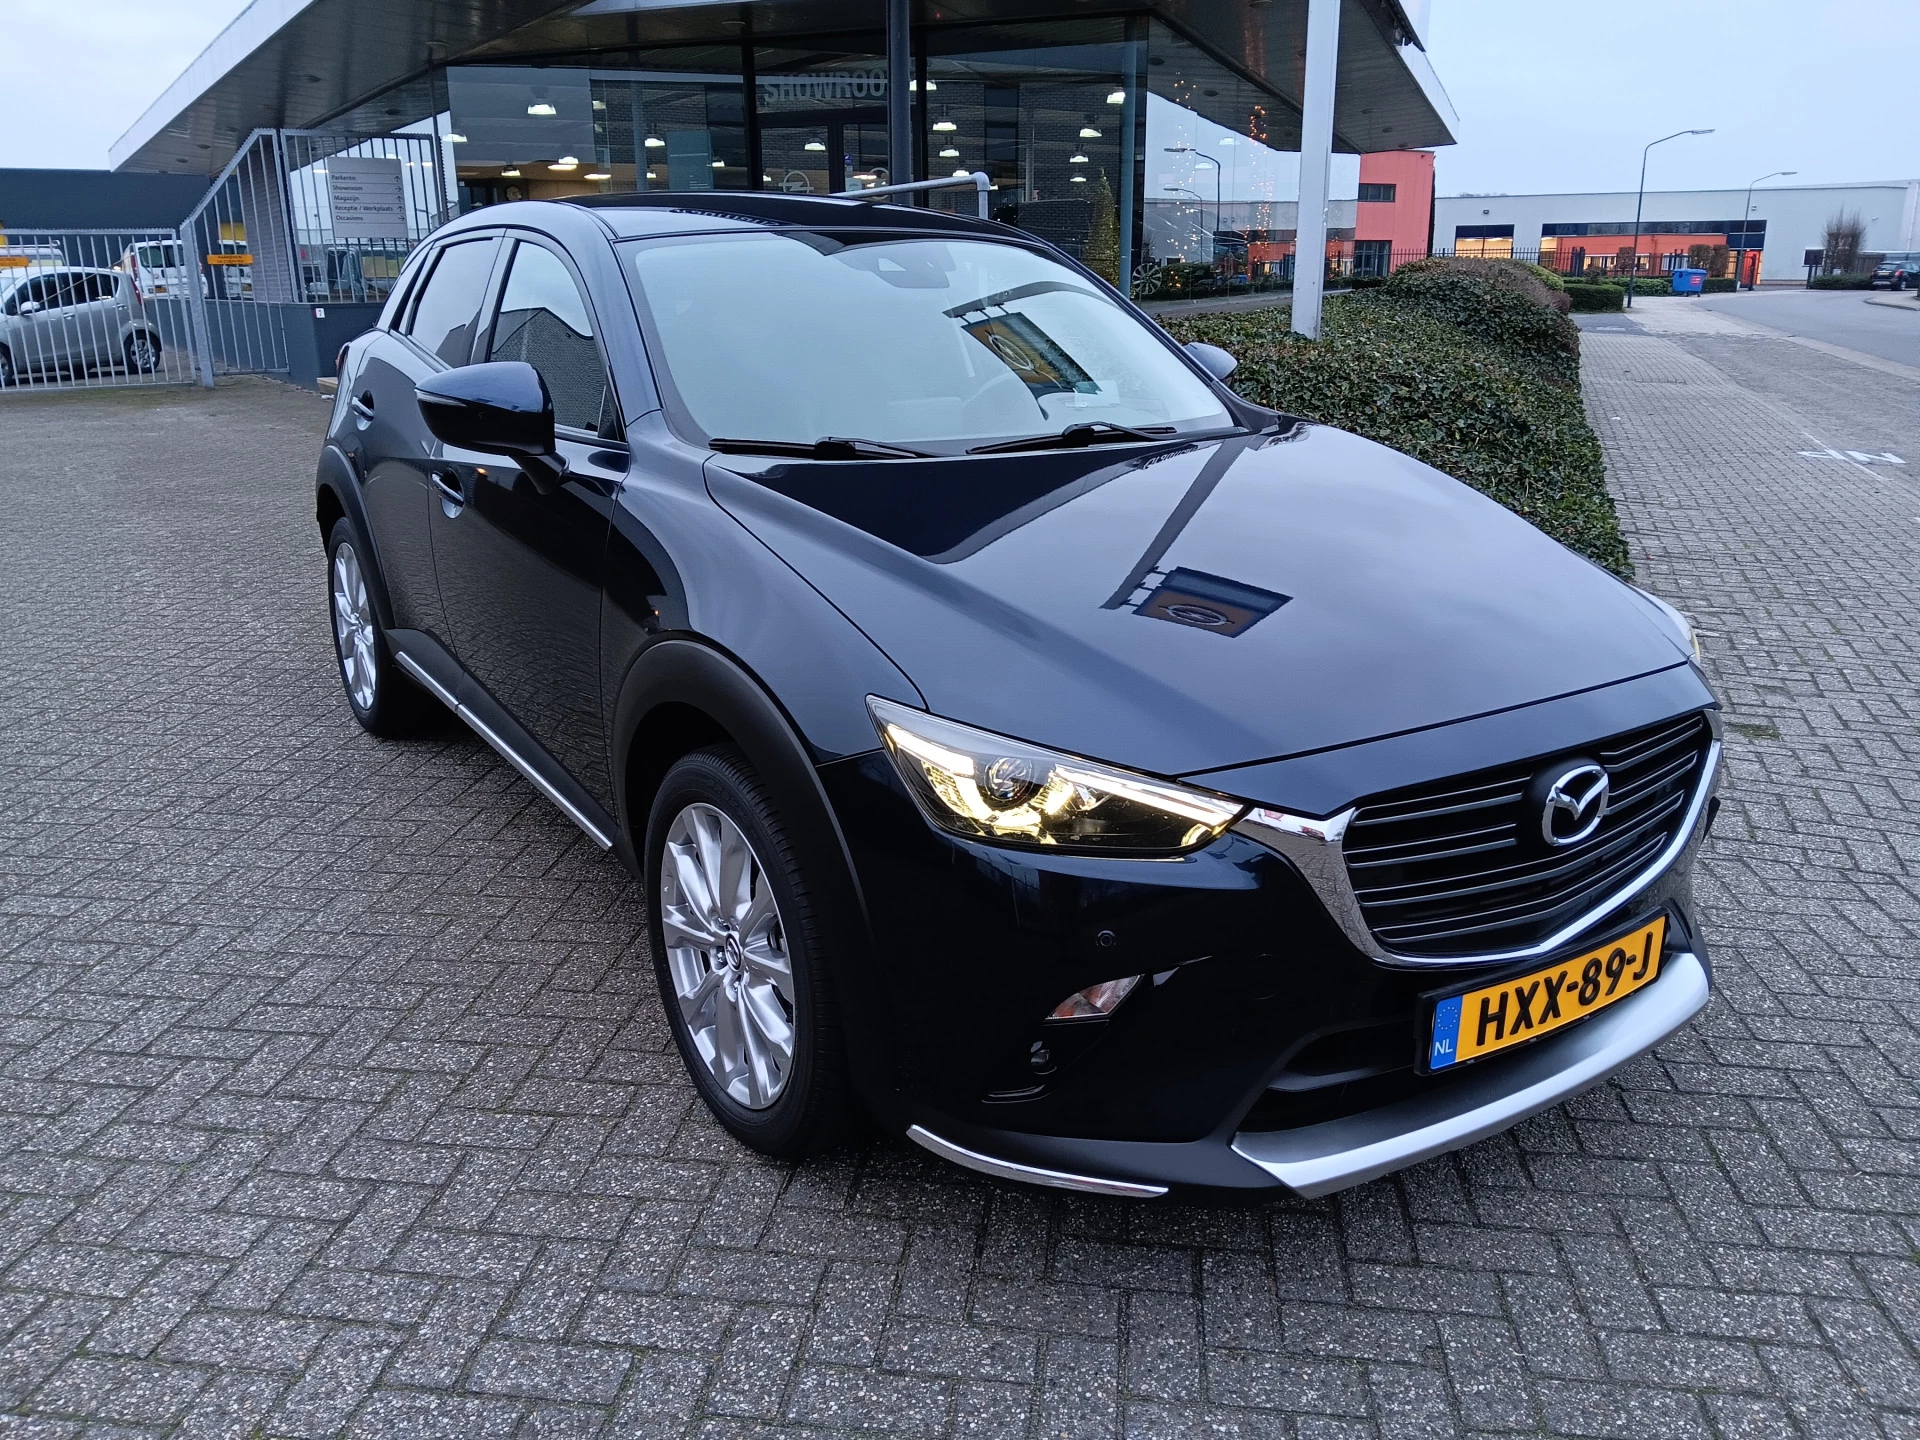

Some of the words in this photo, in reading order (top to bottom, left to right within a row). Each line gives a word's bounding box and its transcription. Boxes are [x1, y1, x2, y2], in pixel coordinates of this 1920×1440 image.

[763, 68, 885, 103] SHOWROO
[333, 195, 360, 203] Magazijn
[1475, 931, 1654, 1047] HXX-89-J
[1434, 1039, 1454, 1057] NL
